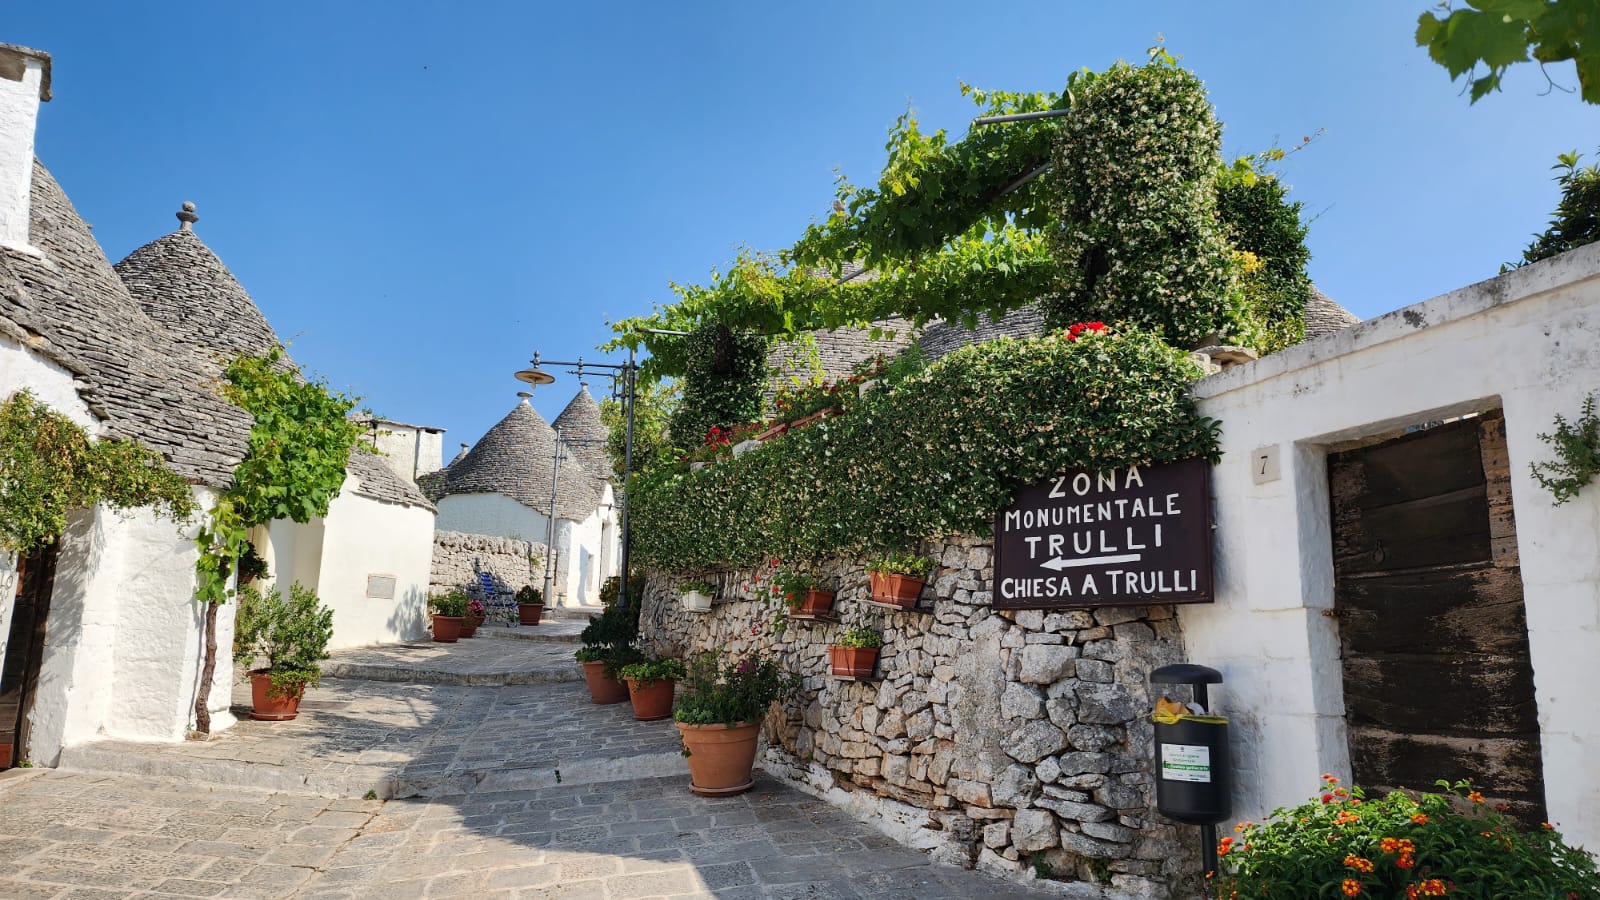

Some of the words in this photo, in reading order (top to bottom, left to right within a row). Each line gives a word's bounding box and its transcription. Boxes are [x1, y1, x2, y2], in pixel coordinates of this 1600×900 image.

[1048, 465, 1144, 499] ZONA
[1260, 455, 1268, 475] 7
[1004, 493, 1181, 532] MONUMENTALE
[1024, 524, 1162, 559] TRULLI
[1001, 576, 1072, 599] CHIESA
[1081, 573, 1099, 595] A
[1105, 569, 1197, 595] TRULLI
